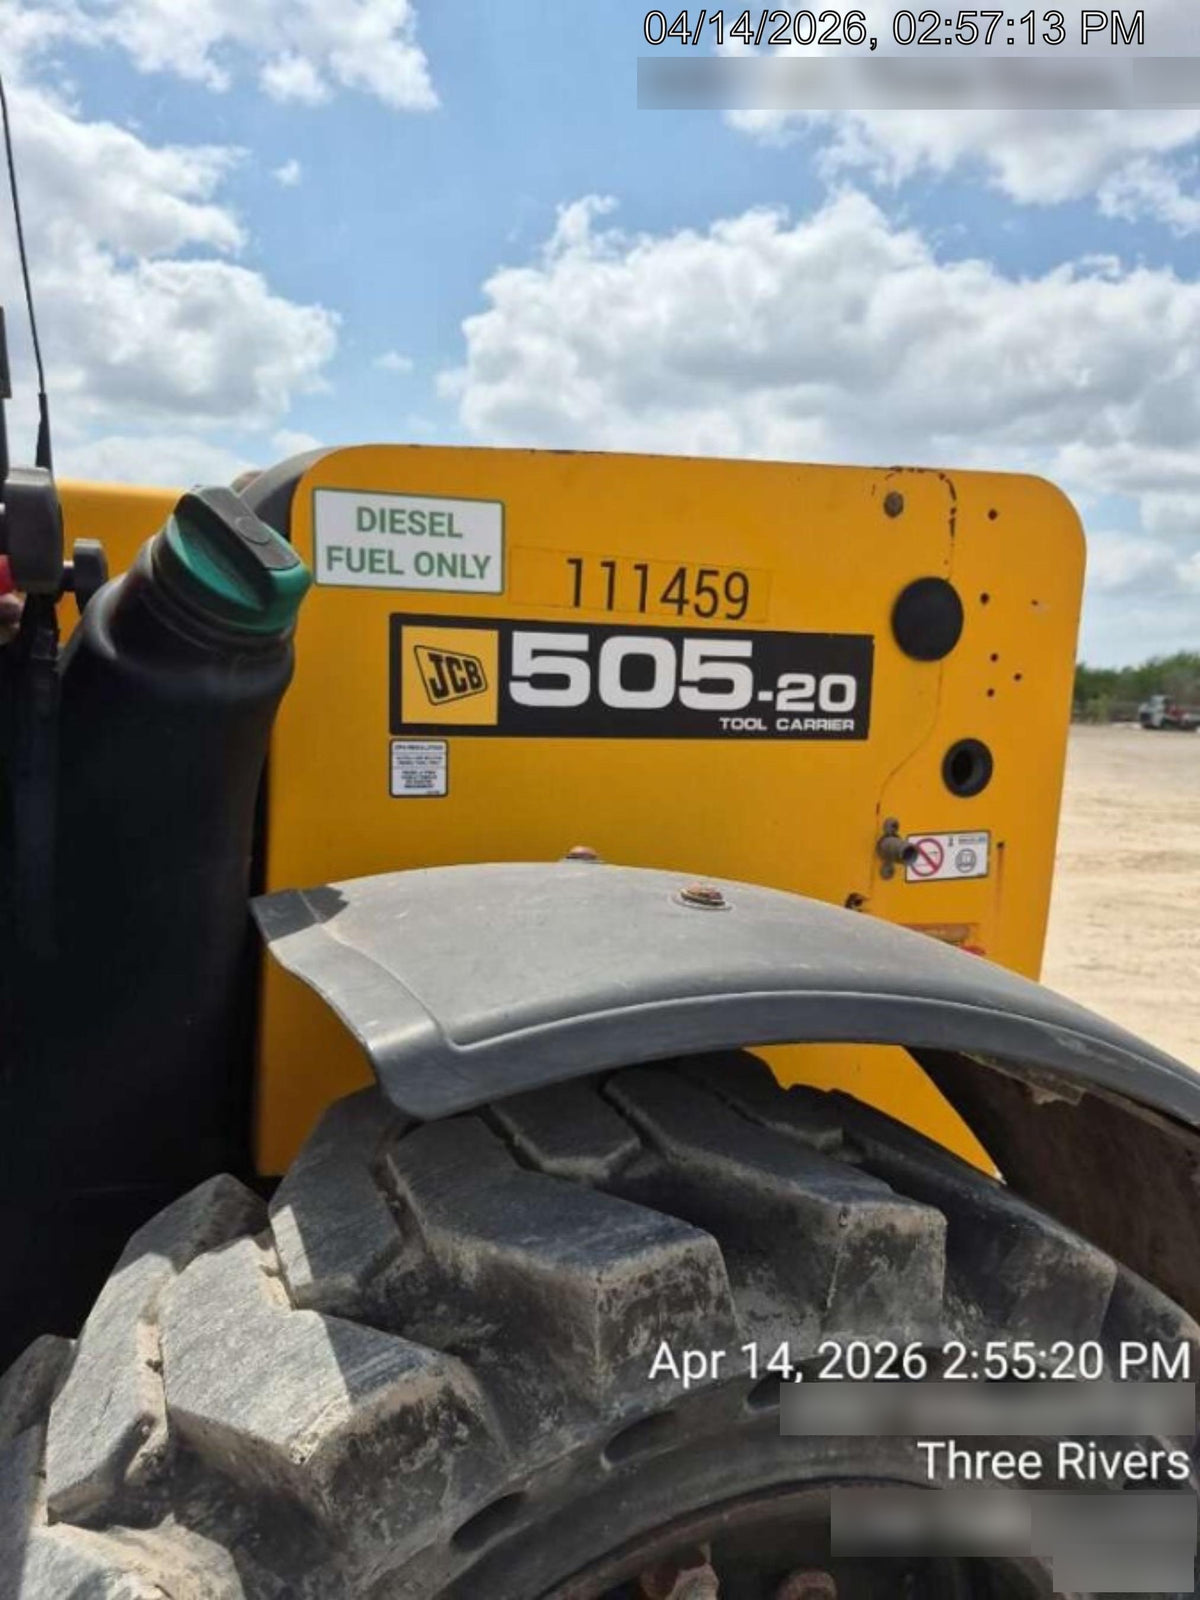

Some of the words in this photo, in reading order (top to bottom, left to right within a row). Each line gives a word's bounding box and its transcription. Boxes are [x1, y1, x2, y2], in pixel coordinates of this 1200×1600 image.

[356, 506, 463, 538] DIESEL
[326, 545, 404, 575] FUEL
[414, 551, 491, 580] ONLY
[567, 557, 749, 621] 111459
[426, 652, 483, 699] JCB
[509, 630, 857, 712] 505-20
[719, 717, 767, 731] TOOL
[776, 718, 855, 732] CARRIER
